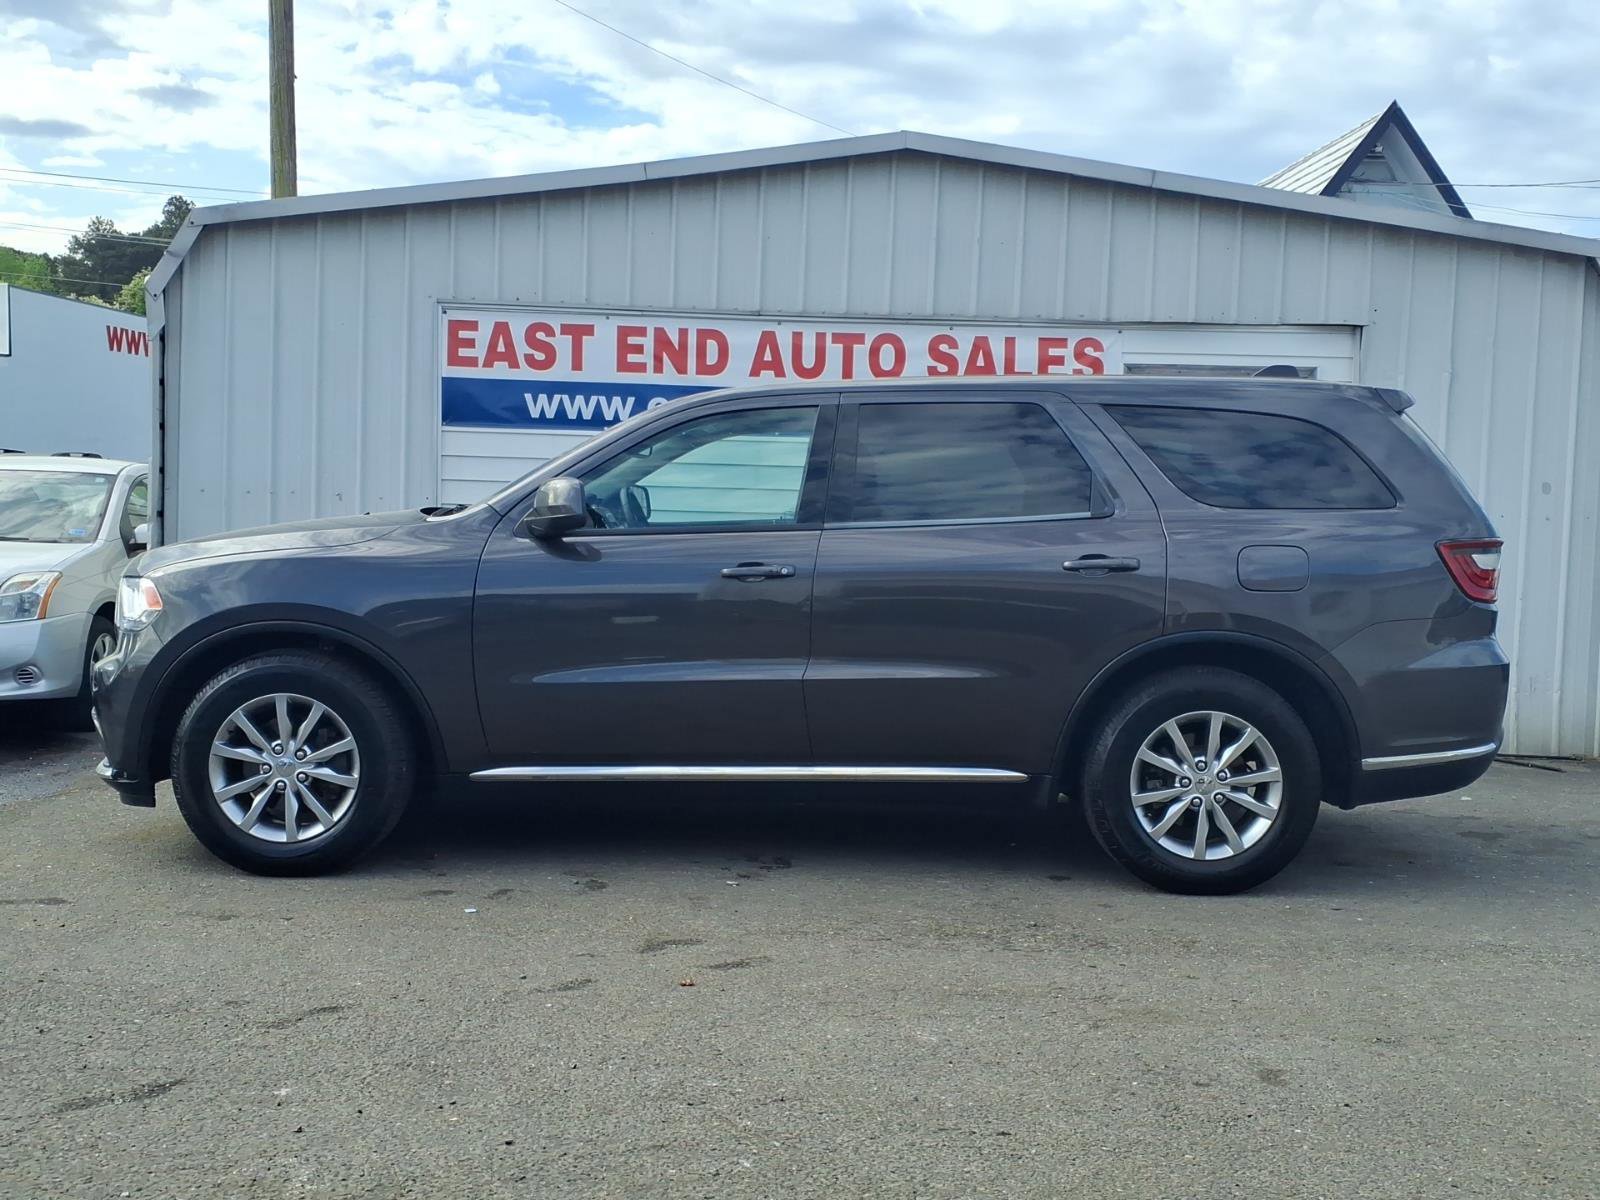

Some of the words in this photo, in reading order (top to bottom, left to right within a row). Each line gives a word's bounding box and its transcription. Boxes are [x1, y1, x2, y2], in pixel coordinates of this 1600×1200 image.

[447, 319, 595, 372] EAST
[616, 325, 730, 376] END
[748, 330, 907, 380] AUTO
[927, 334, 1105, 376] SALES
